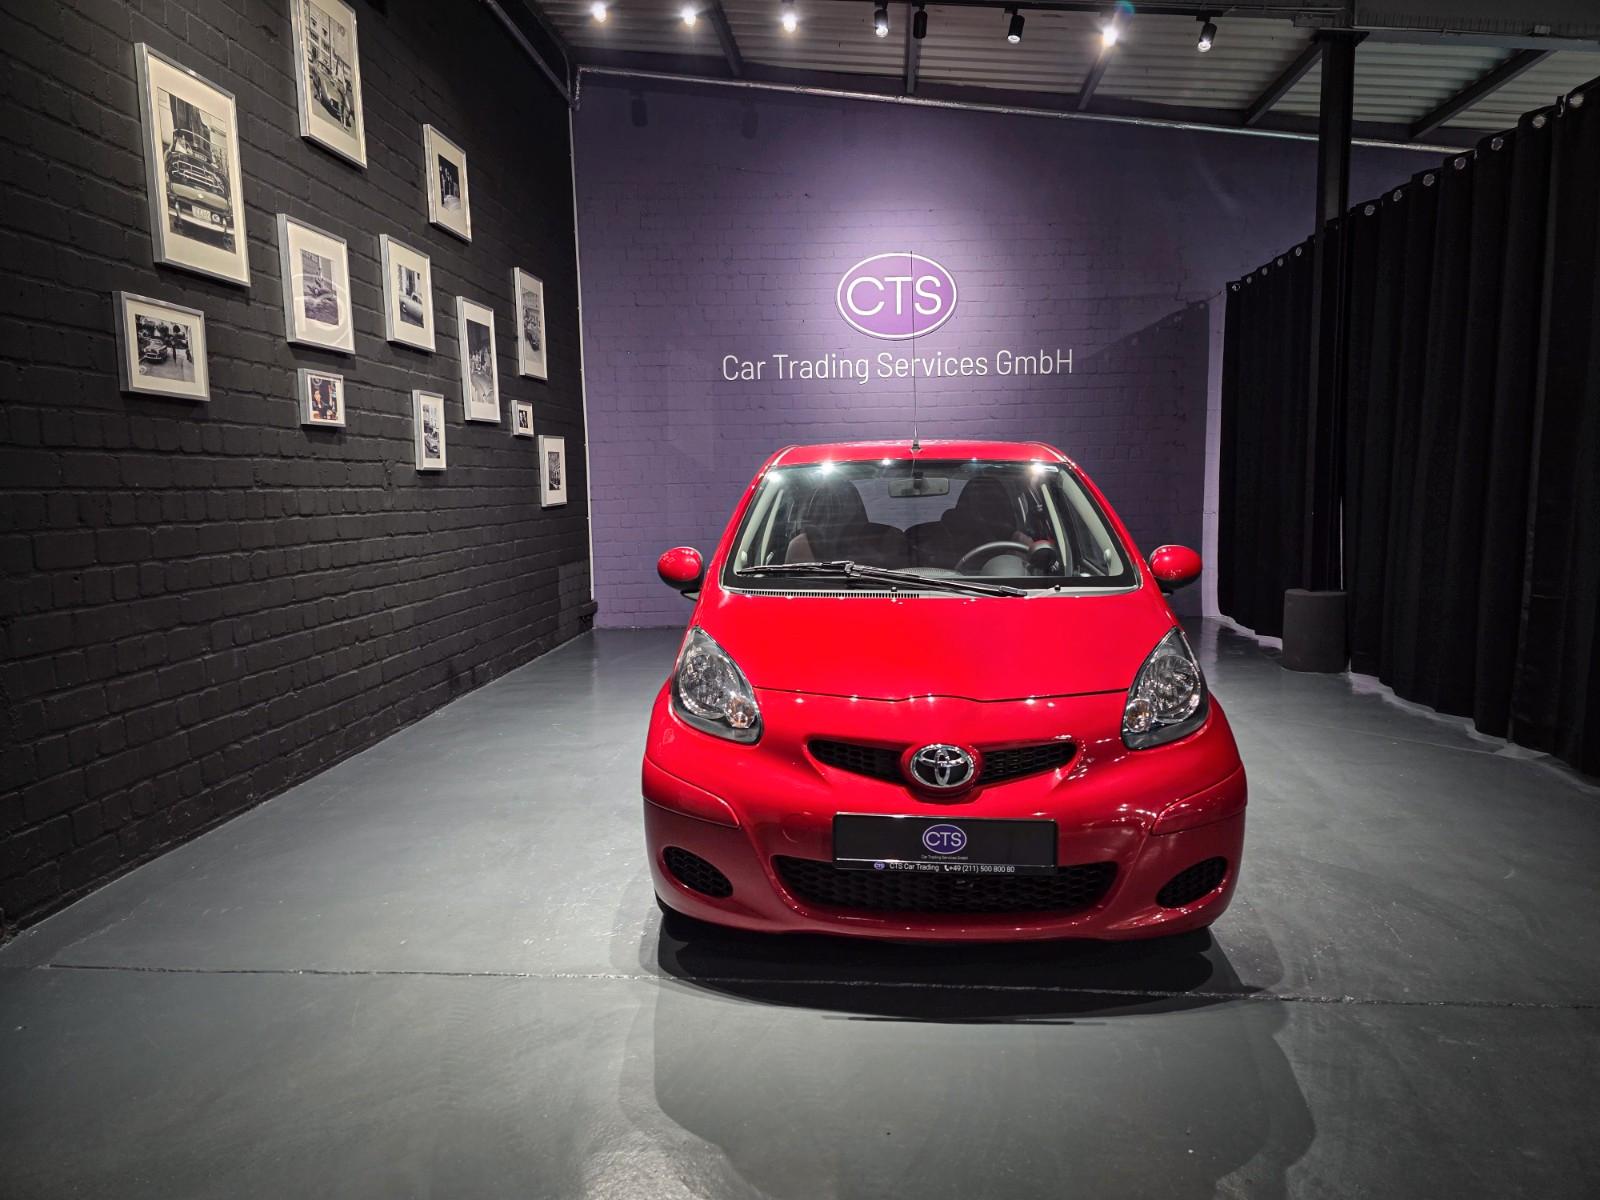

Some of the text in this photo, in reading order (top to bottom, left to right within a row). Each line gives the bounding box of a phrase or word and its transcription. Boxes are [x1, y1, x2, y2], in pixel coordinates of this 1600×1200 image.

[846, 275, 942, 316] CTS
[722, 349, 1073, 384] Car Trading Services GmbH
[925, 831, 962, 847] CTS
[889, 862, 903, 870] CTS
[916, 864, 940, 872] Trading
[962, 864, 979, 873] (211)
[980, 865, 992, 873] 500
